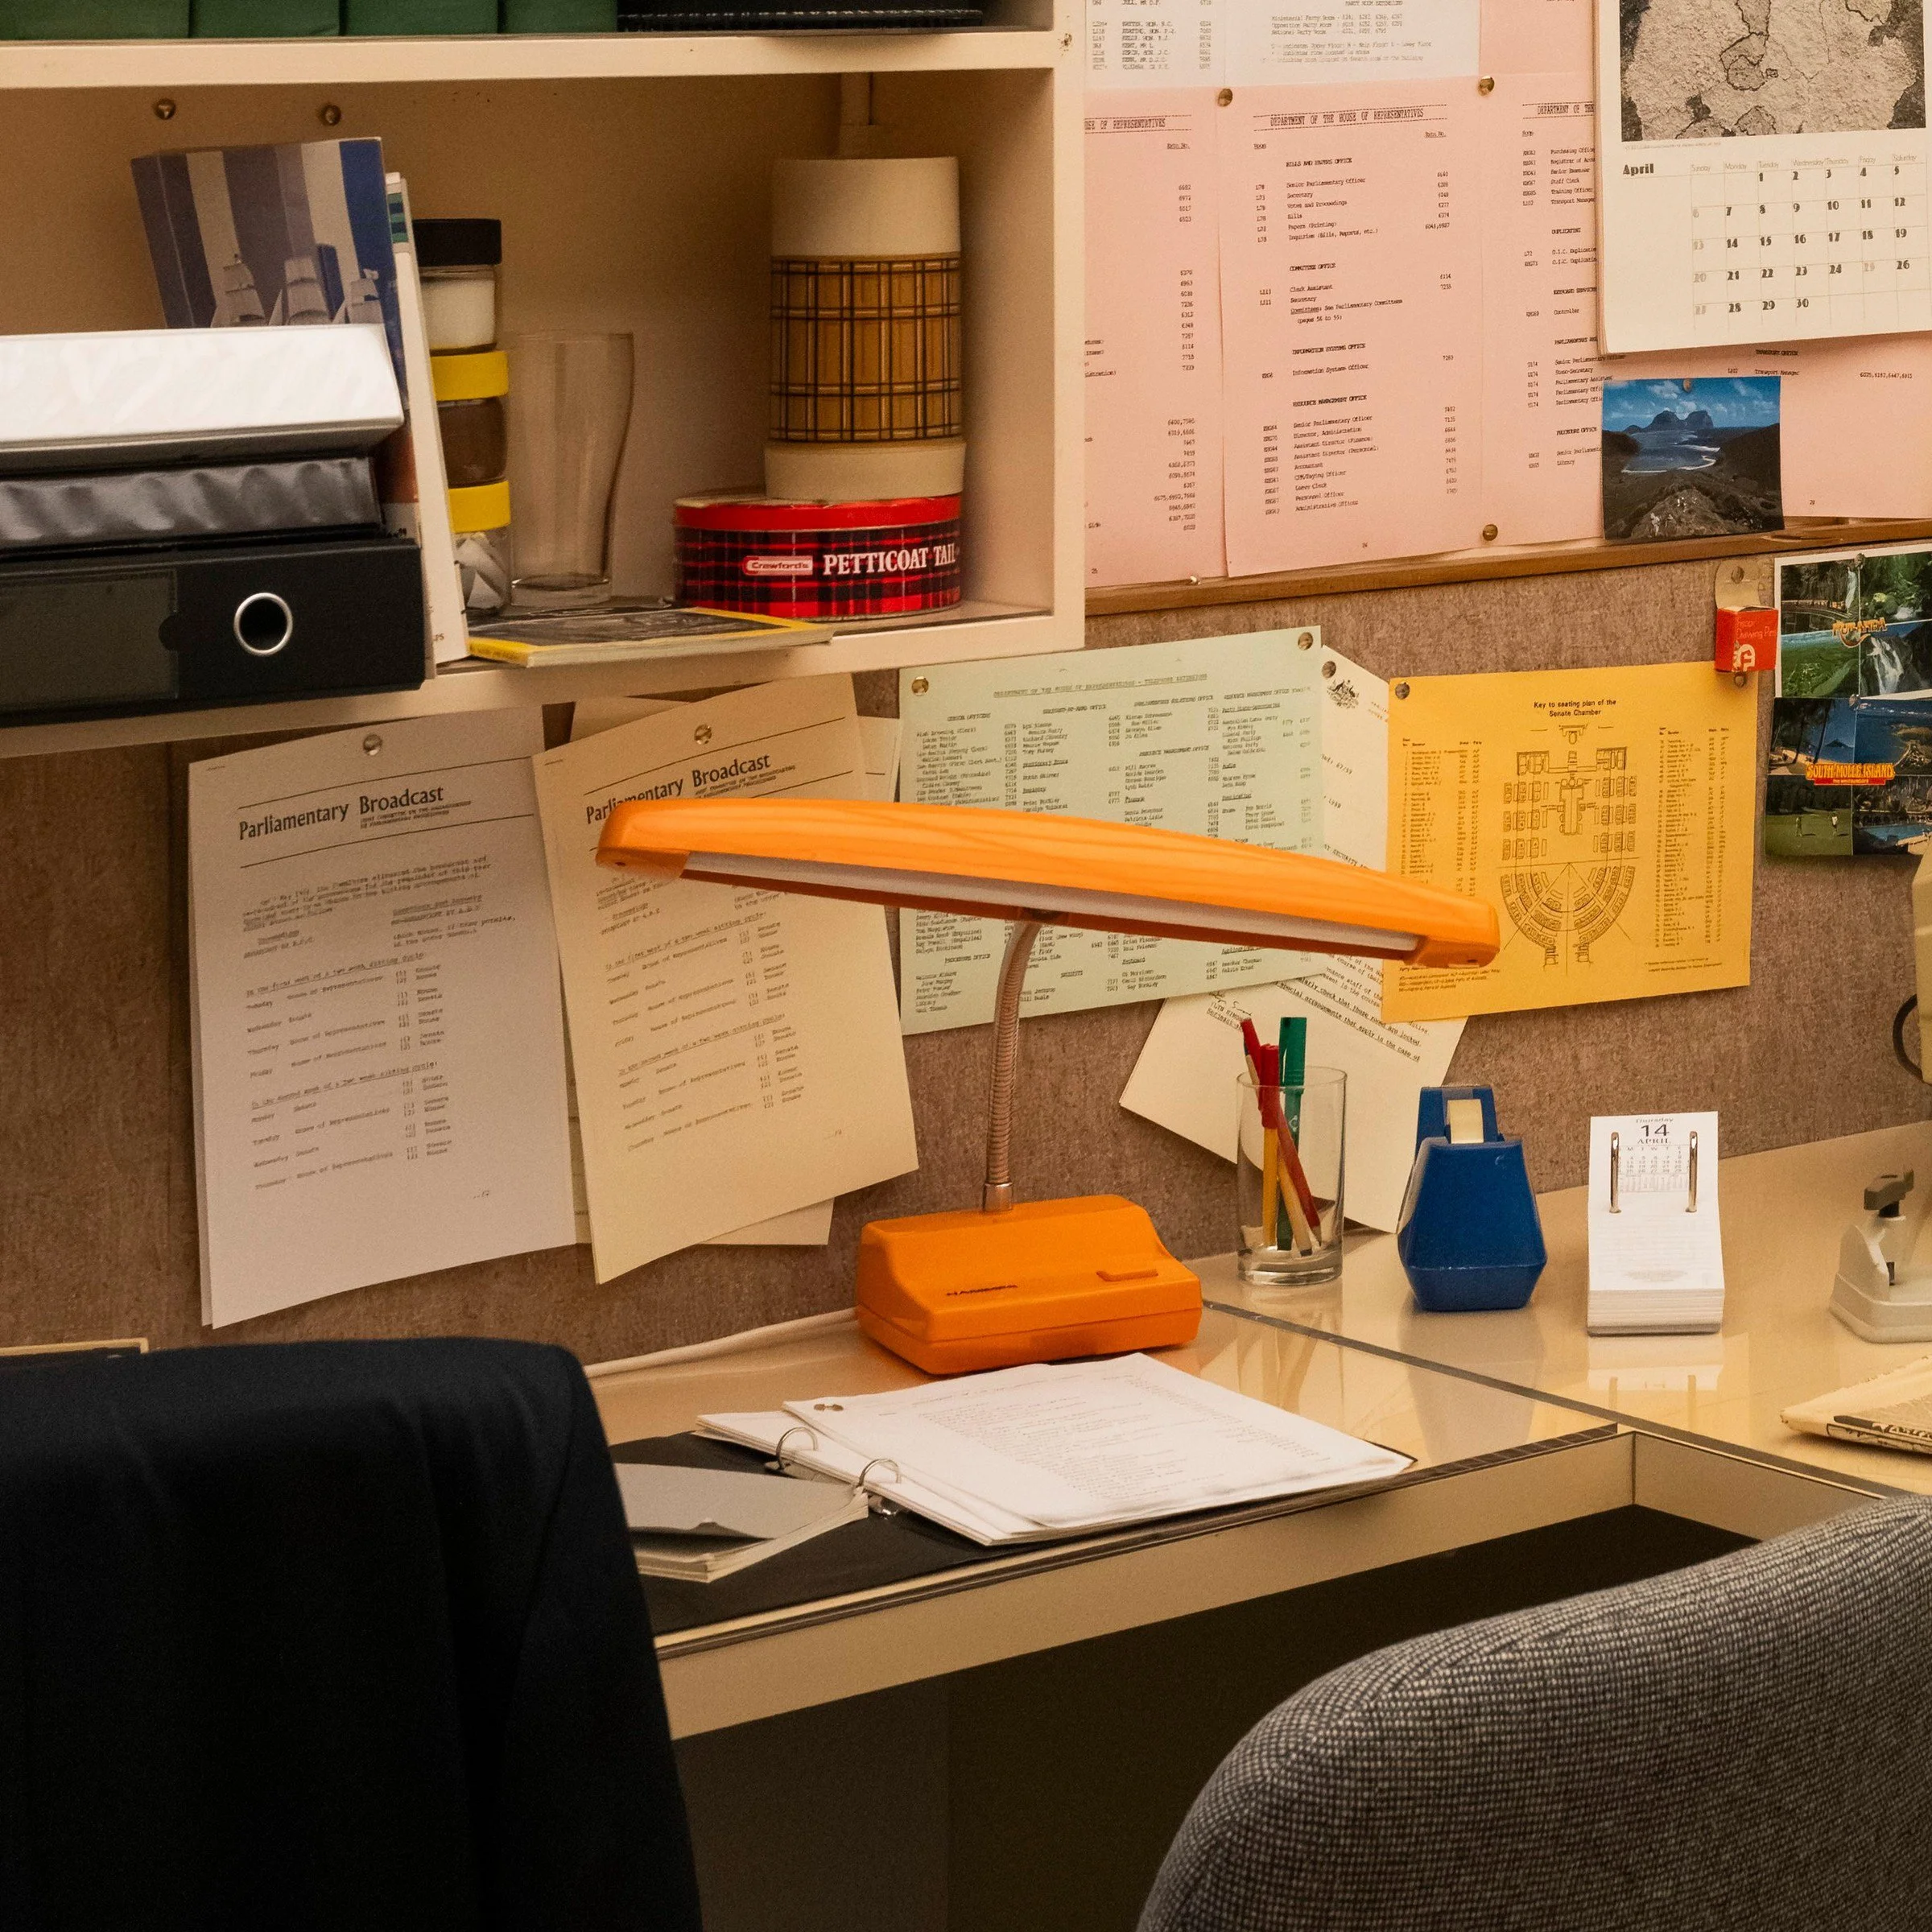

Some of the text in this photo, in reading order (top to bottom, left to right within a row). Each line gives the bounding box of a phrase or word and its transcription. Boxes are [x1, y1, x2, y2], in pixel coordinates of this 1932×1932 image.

[1270, 109, 1424, 126] DEPARTMENT OF THE HOUSE OF REPRESENTATIVES
[1538, 105, 1569, 115] DEPARTMENT
[1573, 104, 1580, 113] OF
[1113, 118, 1166, 129] REPRESENTATIVES
[1622, 163, 1654, 176] April
[1725, 162, 1747, 171] Monday
[1758, 160, 1779, 169] Tuesday
[1893, 154, 1917, 163] Saturday
[1758, 166, 1900, 182] 1 2 3 4 5
[1726, 206, 1732, 217] 7
[1759, 204, 1766, 215] 8
[1793, 203, 1800, 213] 9
[1827, 200, 1839, 211] 10
[1860, 199, 1872, 208] 11
[1894, 197, 1905, 207] 12
[1726, 238, 1738, 249] 14
[1761, 236, 1772, 246] 15
[1794, 234, 1806, 245] 16
[1828, 233, 1840, 242] 17
[1862, 230, 1873, 241] 18
[1896, 229, 1907, 238] 19
[1727, 270, 1740, 281] 21
[1761, 268, 1773, 279] 22
[1795, 266, 1808, 276] 23
[1829, 264, 1842, 275] 24
[1897, 260, 1909, 270] 26
[1728, 303, 1741, 313] 28
[1762, 300, 1775, 311] 29
[1796, 298, 1809, 308] 30
[823, 548, 928, 576] PETTICOAT
[1583, 700, 1596, 708] plan
[691, 754, 771, 787] Broadcast
[1807, 764, 1893, 778] SOUTH MOLLE ISLAND
[239, 786, 444, 840] Parliamentary Broadcast
[1641, 1124, 1670, 1137] 14
